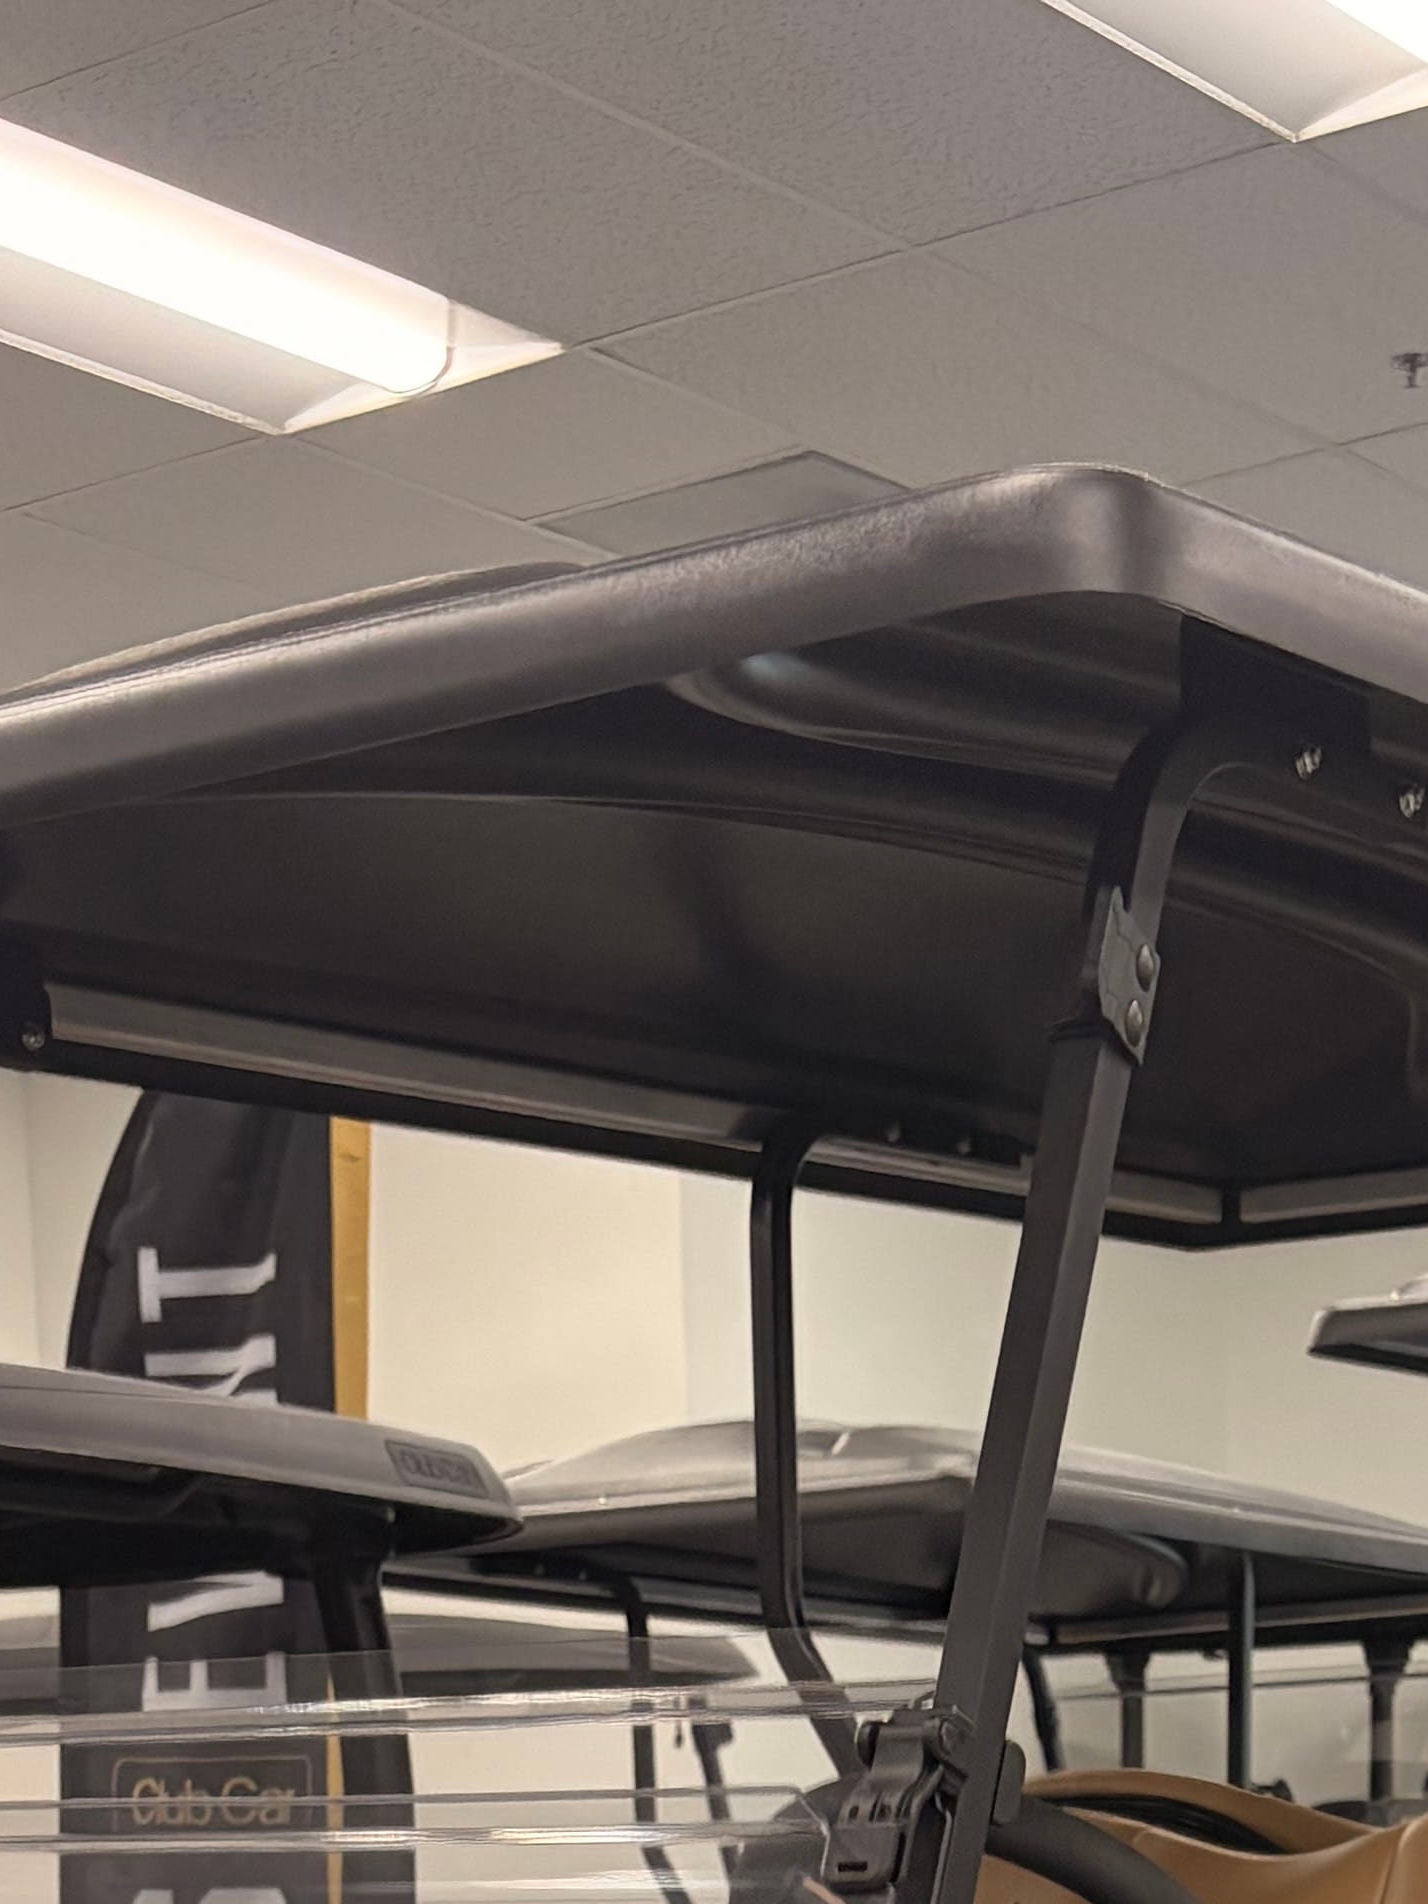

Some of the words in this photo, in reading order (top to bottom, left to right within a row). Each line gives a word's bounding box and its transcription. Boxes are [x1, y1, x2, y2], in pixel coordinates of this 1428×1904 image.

[136, 1246, 286, 1712] EVNT
[132, 1777, 214, 1826] Club
[220, 1776, 296, 1826] Car
